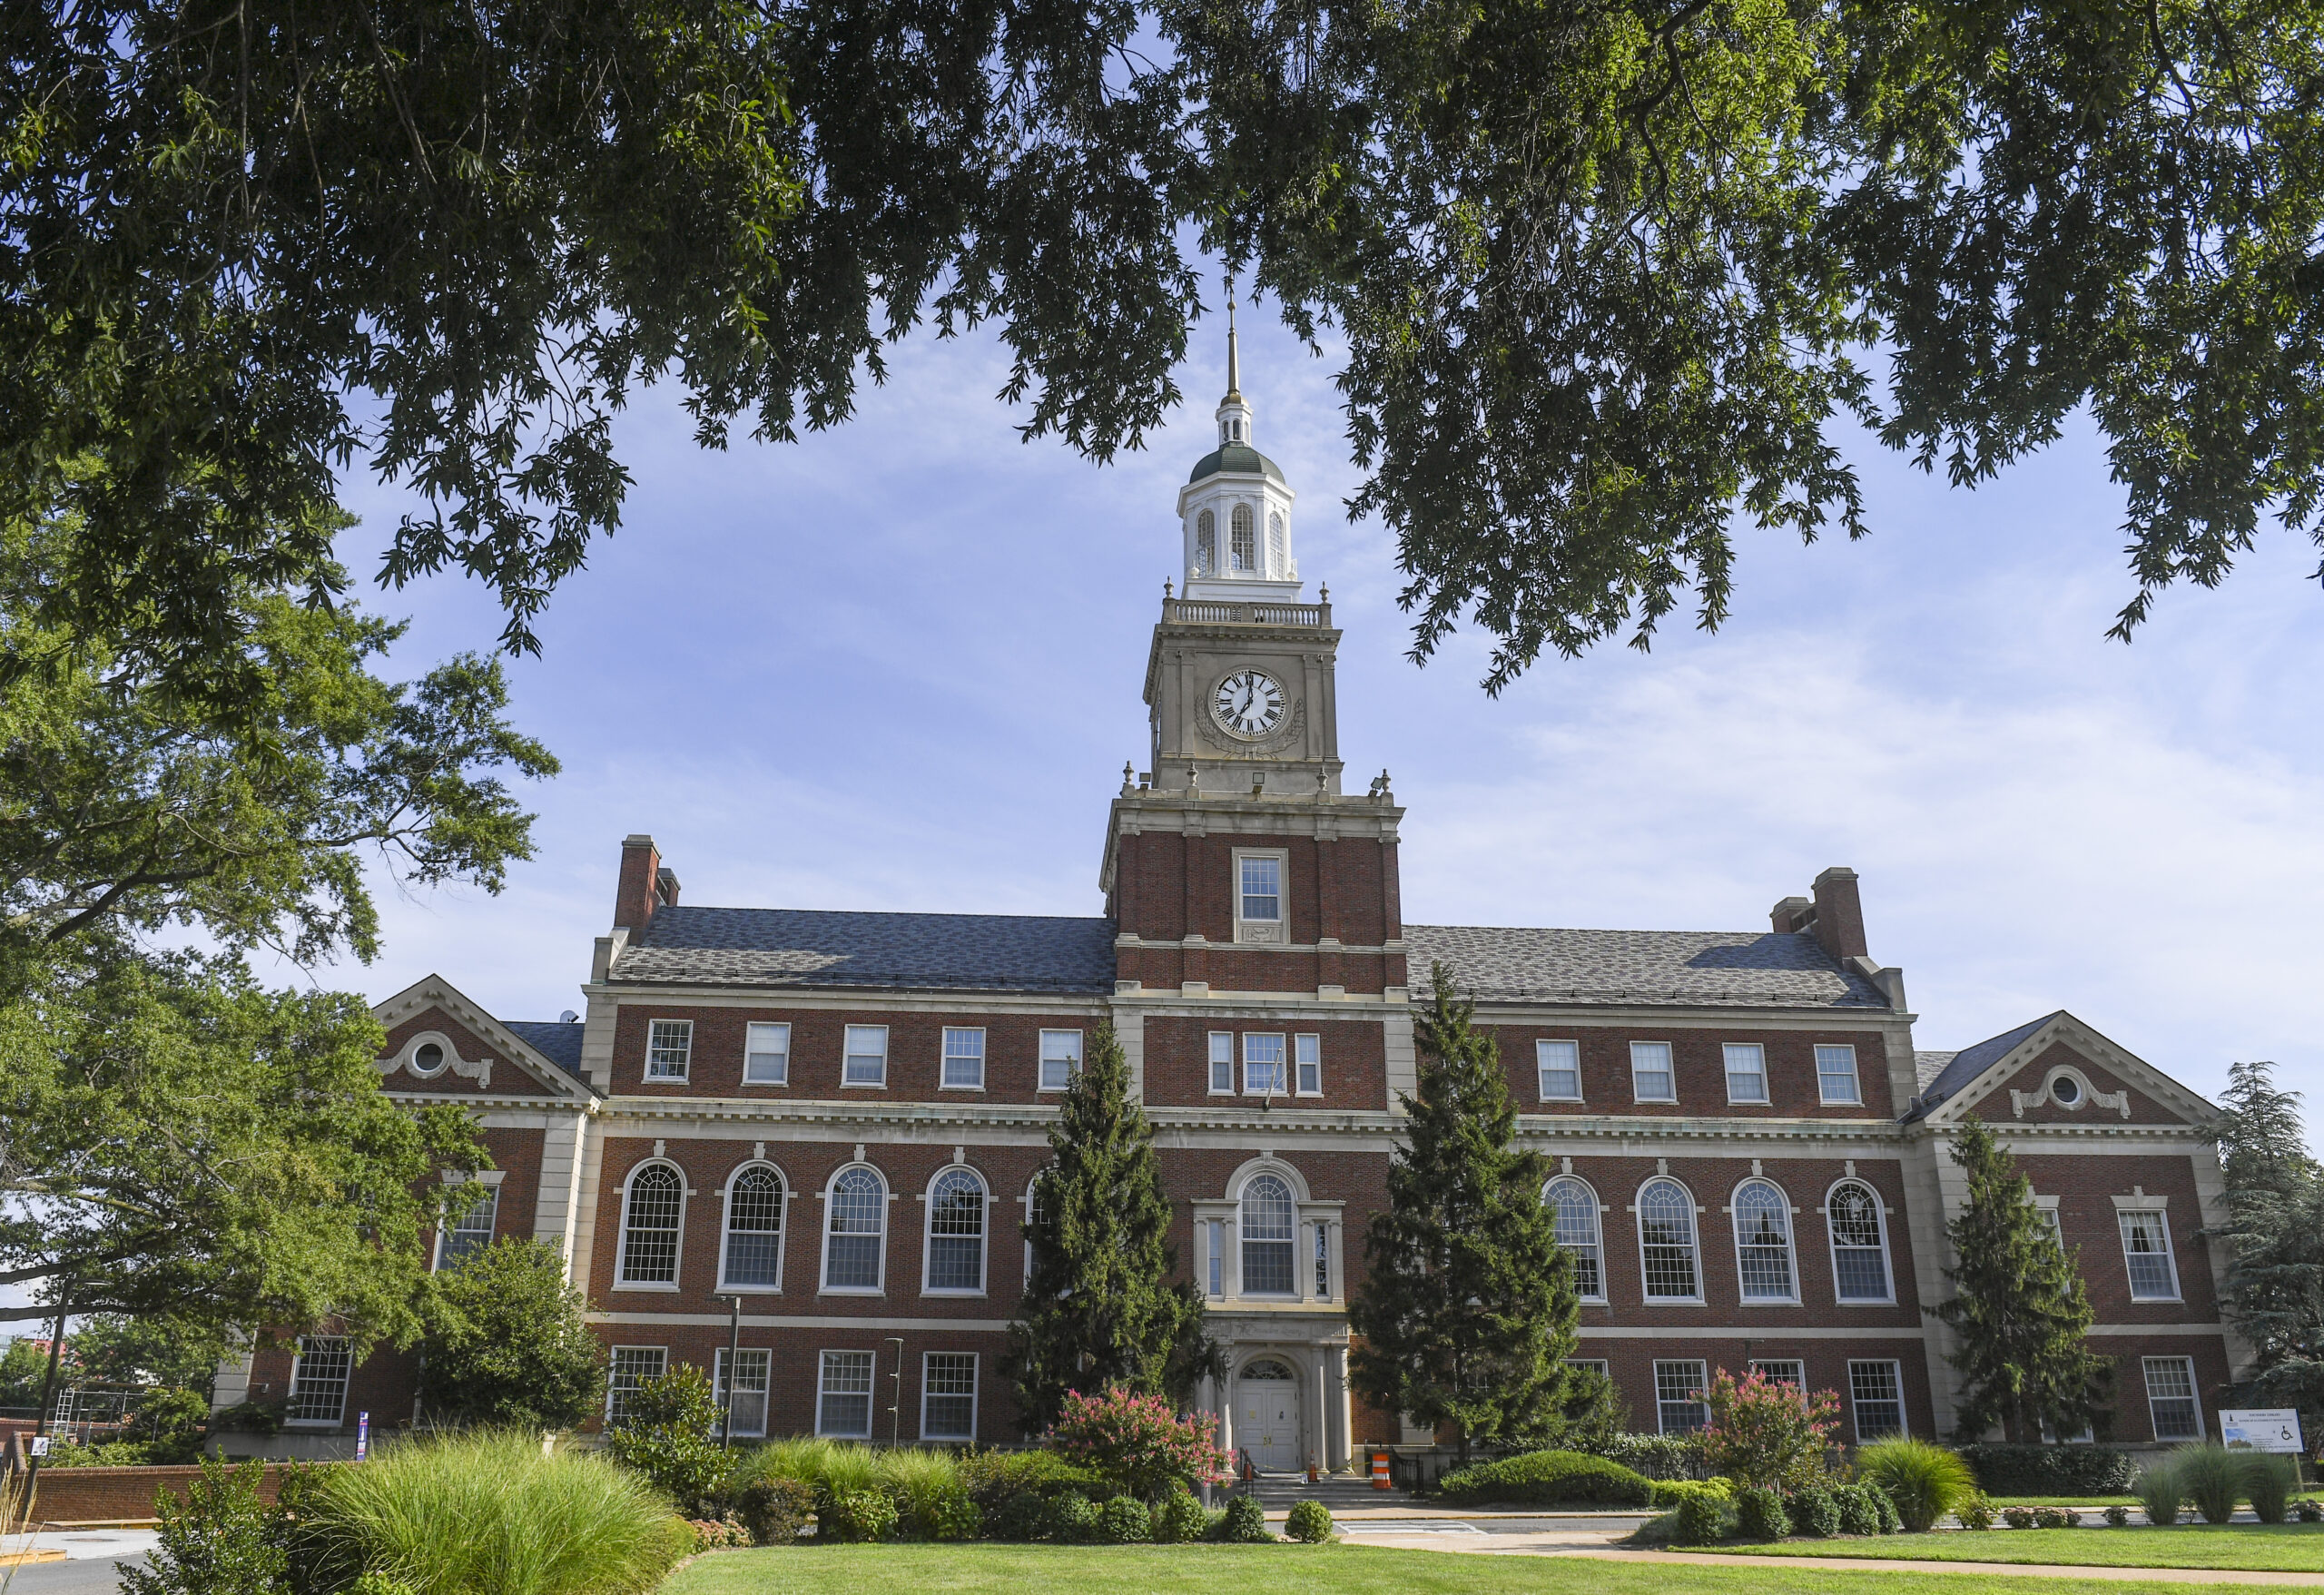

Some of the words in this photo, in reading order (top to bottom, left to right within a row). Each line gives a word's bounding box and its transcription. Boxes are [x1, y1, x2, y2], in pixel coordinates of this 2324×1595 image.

[1245, 674, 1254, 686] XI
[1258, 678, 1265, 689] I
[1265, 687, 1277, 696] II
[1221, 706, 1236, 720] VIII
[1264, 708, 1278, 721] IIII
[1247, 719, 1254, 732] VI
[1258, 717, 1267, 728] V
